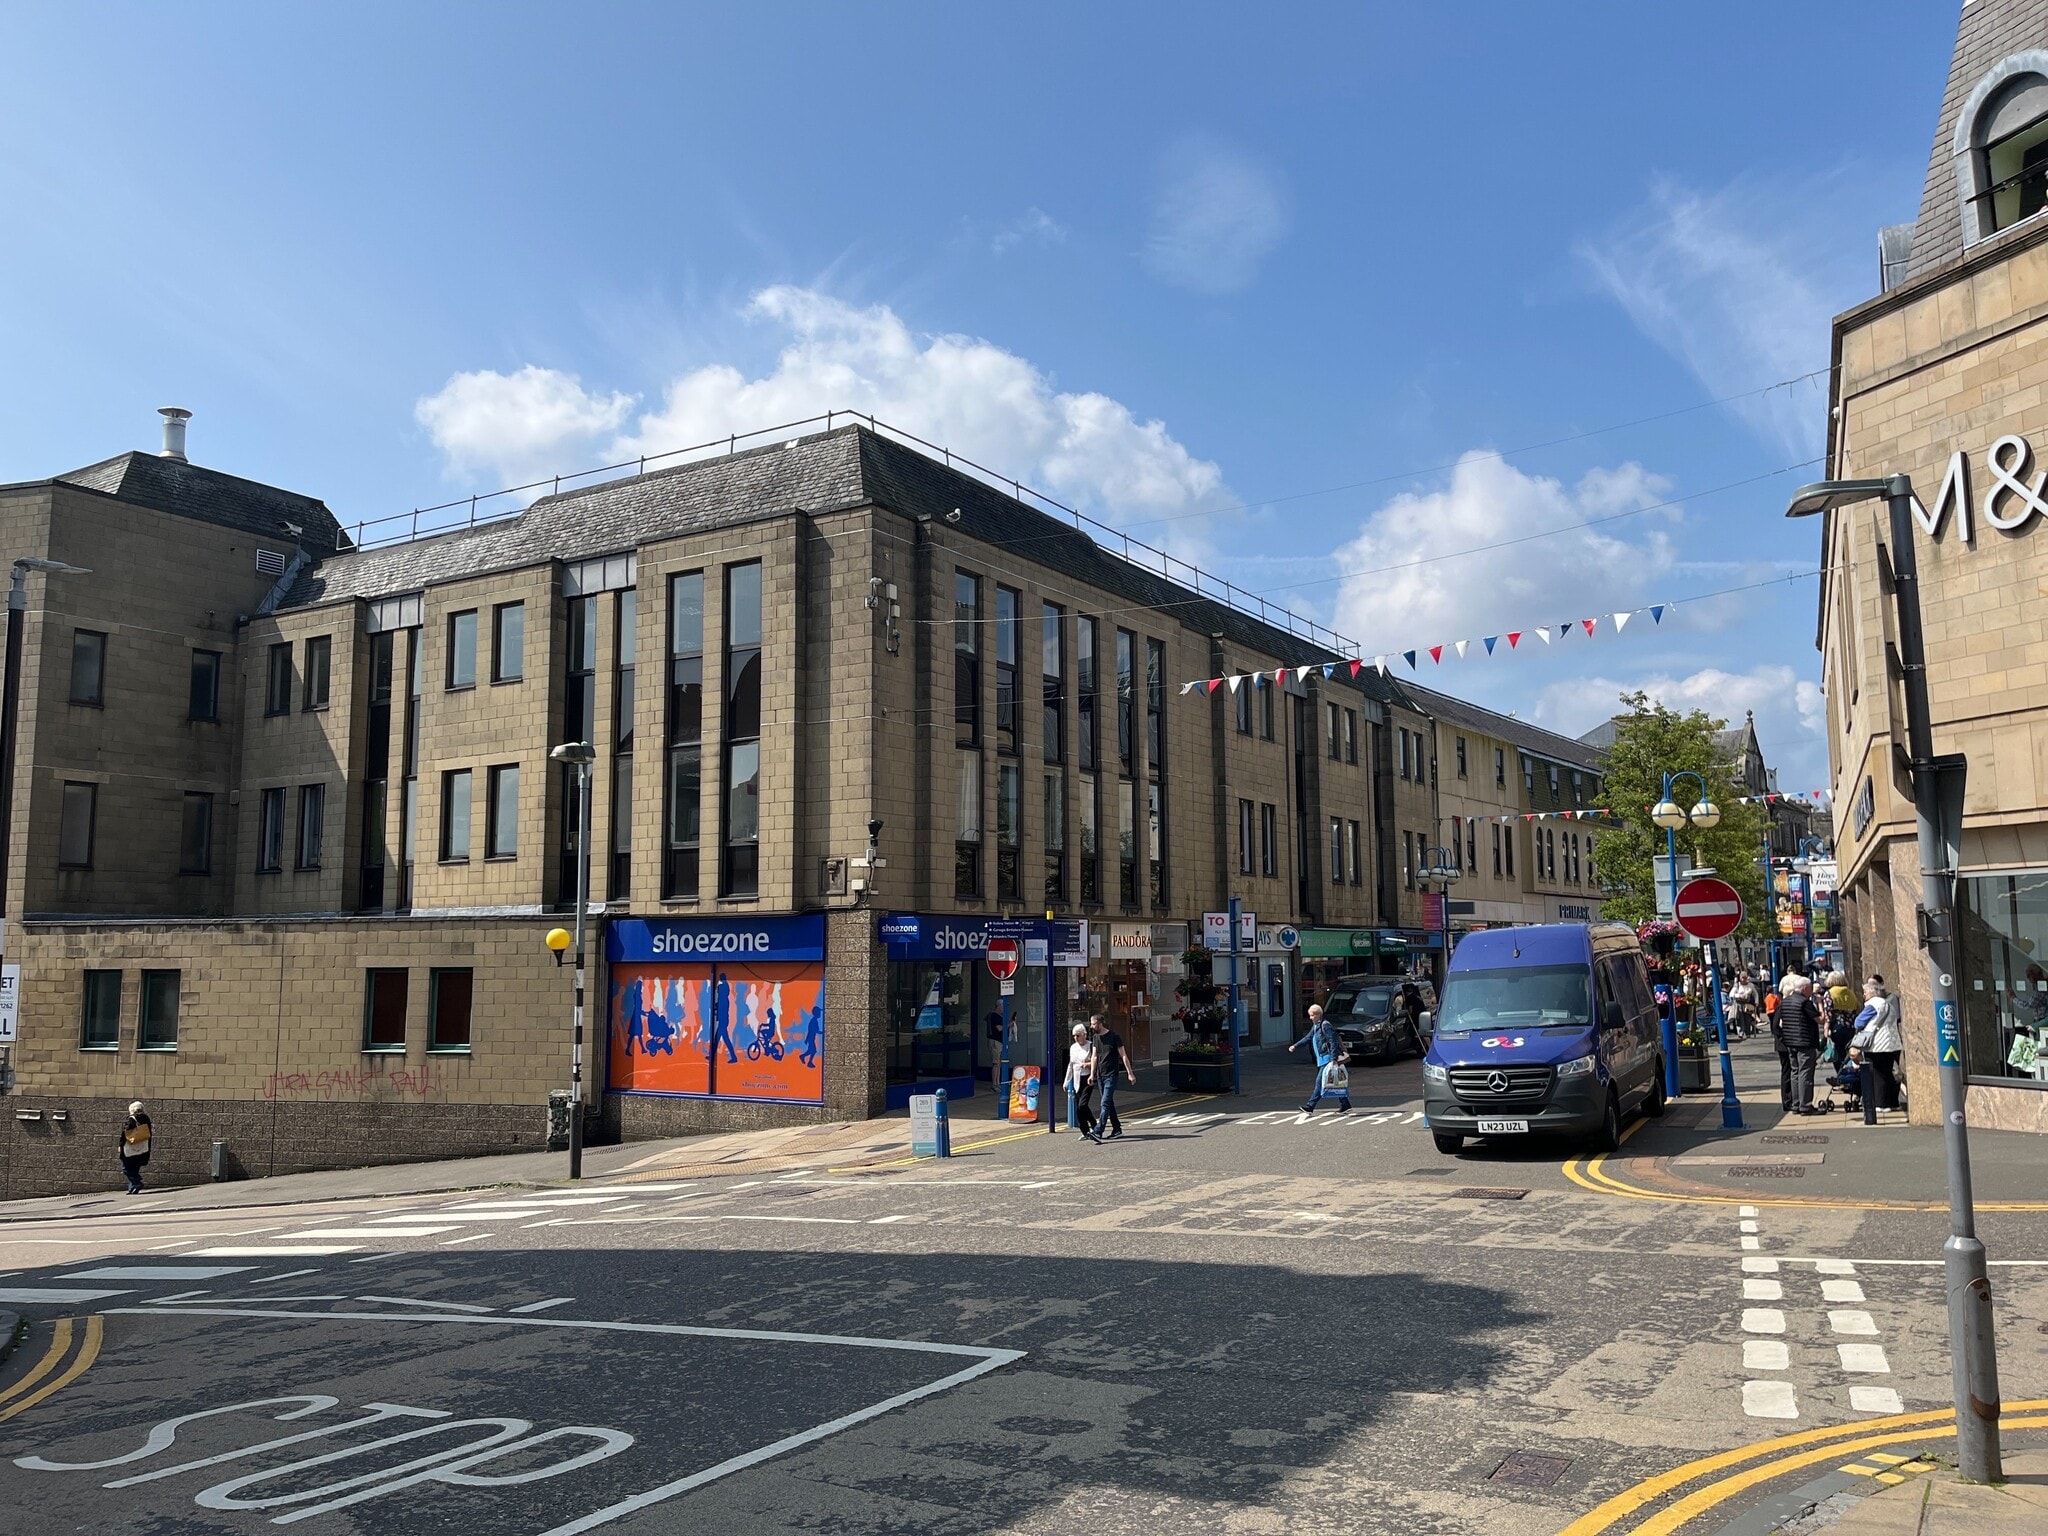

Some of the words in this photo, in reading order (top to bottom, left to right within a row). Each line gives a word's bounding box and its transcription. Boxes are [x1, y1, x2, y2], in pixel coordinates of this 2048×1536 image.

[1559, 905, 1590, 919] PRIMARK
[1207, 916, 1225, 926] TO
[881, 923, 917, 933] shoezone
[653, 928, 770, 953] shoezone
[935, 927, 988, 950] shoez
[1113, 935, 1152, 948] PANDORA
[2, 977, 15, 989] ET
[1481, 1122, 1505, 1131] LN23
[1506, 1122, 1524, 1131] UZL
[12, 1395, 635, 1525] STOP
